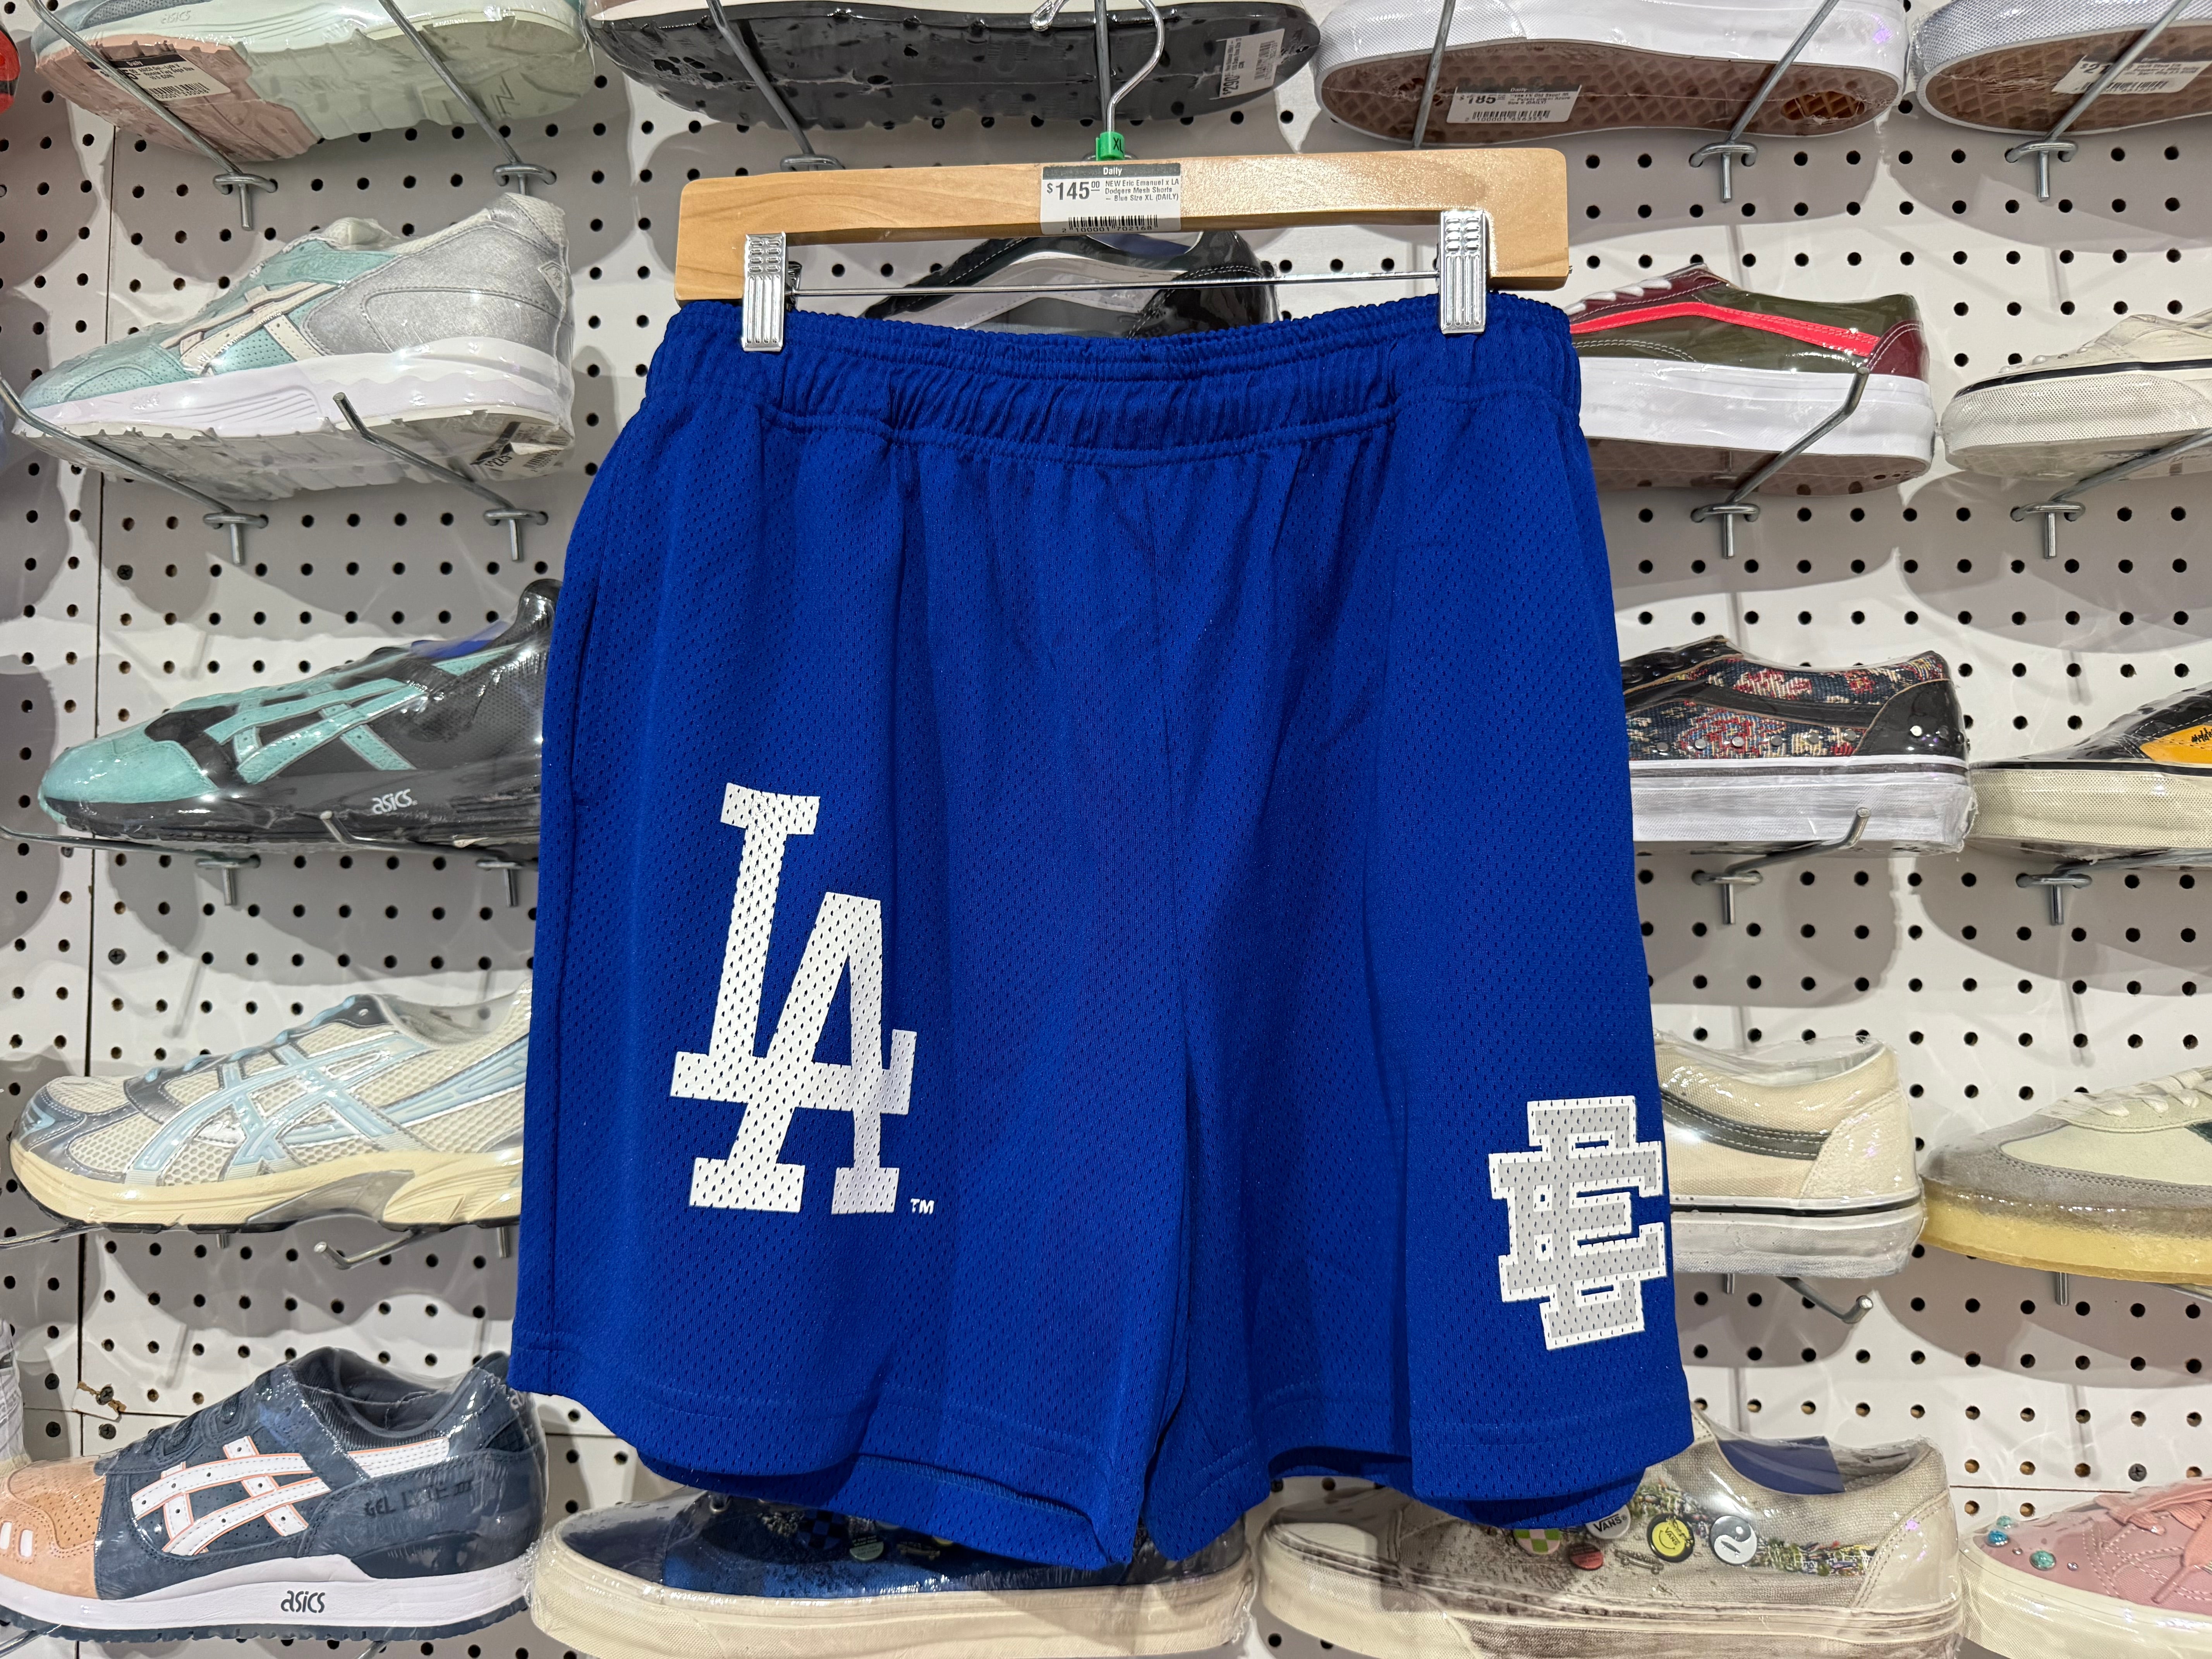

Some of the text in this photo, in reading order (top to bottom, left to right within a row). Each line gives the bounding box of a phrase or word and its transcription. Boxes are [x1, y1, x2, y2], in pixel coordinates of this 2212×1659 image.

[1113, 137, 1124, 154] XL
[1103, 167, 1122, 176] Daily
[1105, 187, 1131, 196] Dodgers
[1156, 193, 1179, 201] (DAILY)
[372, 788, 413, 815] asics
[671, 782, 917, 1214] LA
[365, 1496, 397, 1518] GEL
[1665, 1527, 1681, 1546] VANS
[280, 1590, 326, 1614] asics
